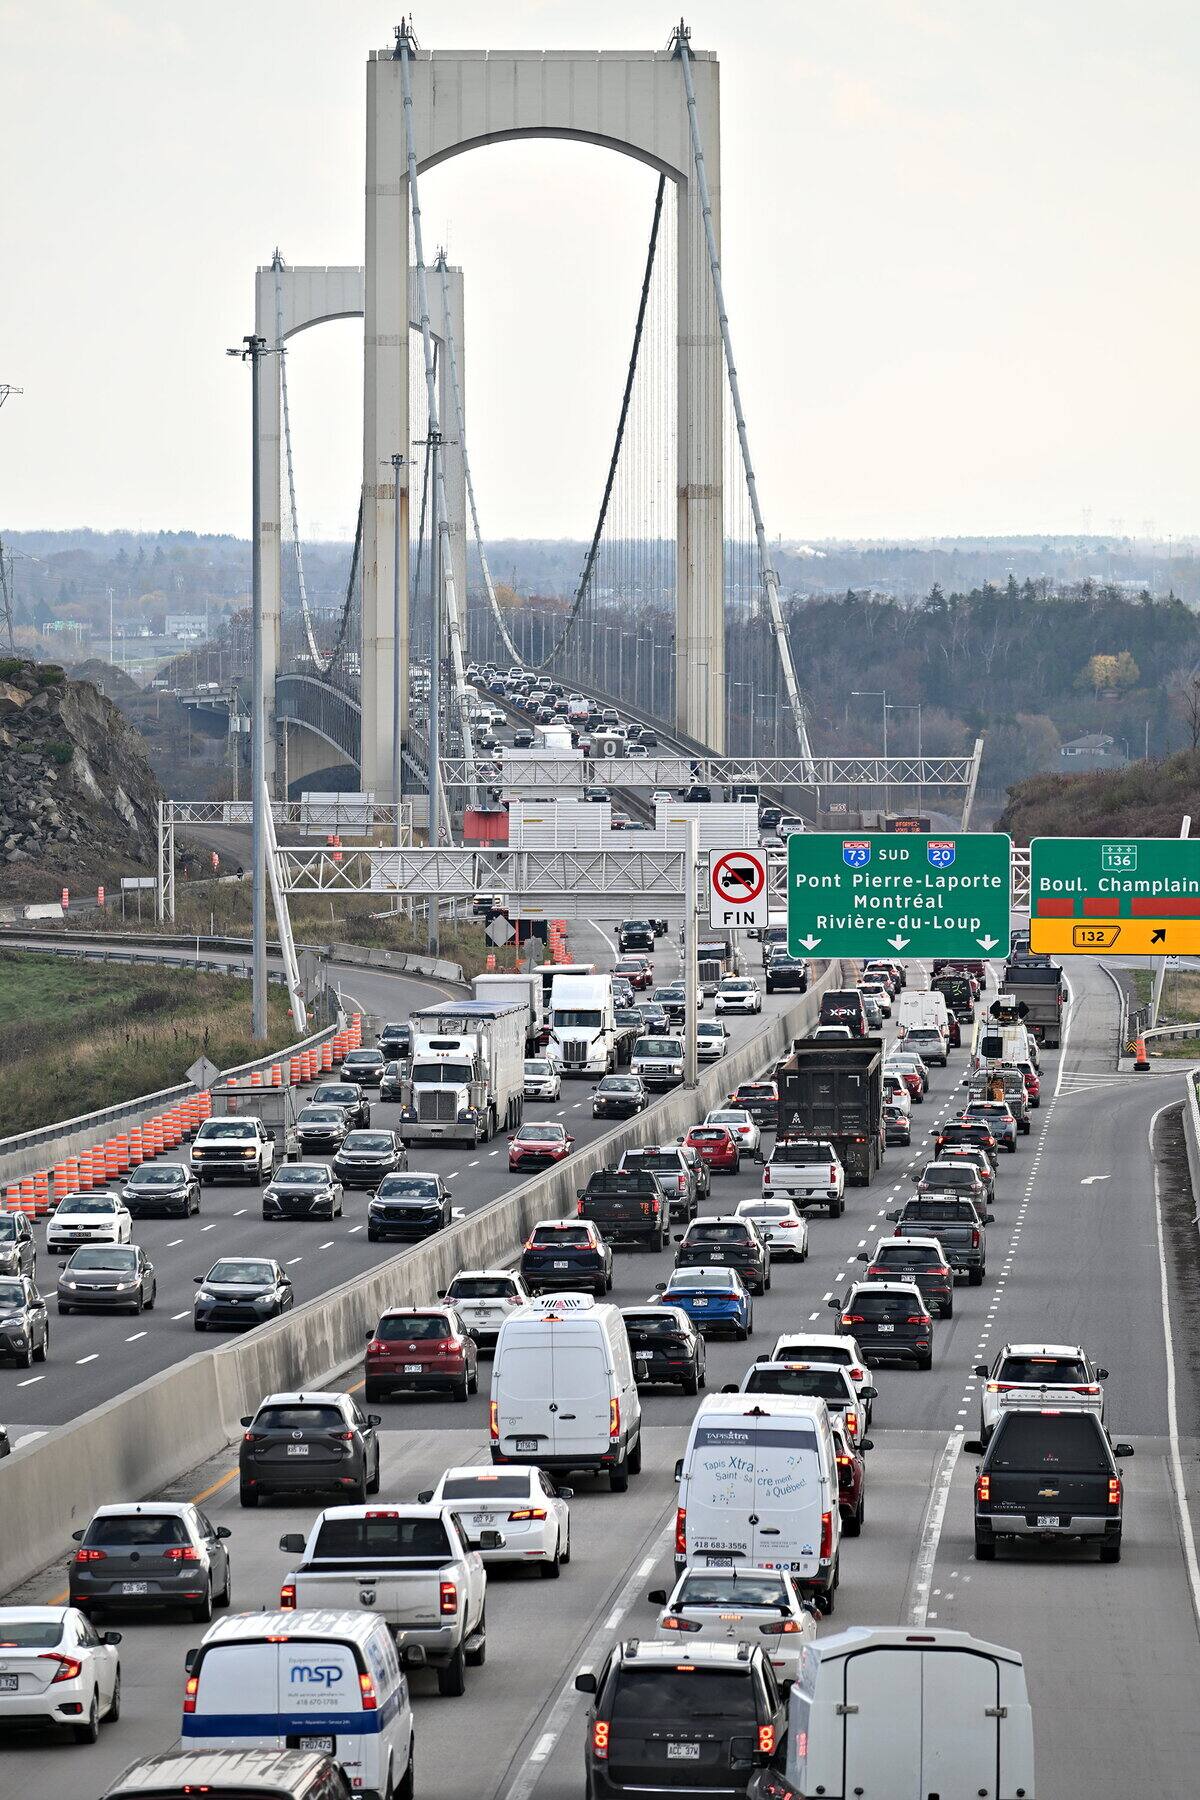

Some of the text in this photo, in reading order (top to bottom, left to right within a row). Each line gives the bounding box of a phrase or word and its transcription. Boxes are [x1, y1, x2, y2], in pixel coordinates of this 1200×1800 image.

[848, 850, 866, 861] 73
[878, 849, 910, 861] SUD
[932, 850, 950, 861] 20
[1107, 855, 1131, 866] 136
[796, 873, 1002, 891] Pont Pierre-Laporte
[1039, 876, 1199, 895] Boul. Champlain
[854, 894, 944, 909] Montréal
[723, 911, 755, 925] FIN
[816, 914, 981, 932] Rivière-du-Loup
[1081, 931, 1105, 942] 132
[829, 1008, 857, 1017] XPN
[703, 1459, 726, 1471] Tapis
[715, 1471, 738, 1481] Saint
[773, 1478, 807, 1498] Québec!
[694, 1541, 748, 1550] 418 683-3556
[290, 1665, 343, 1688] msp
